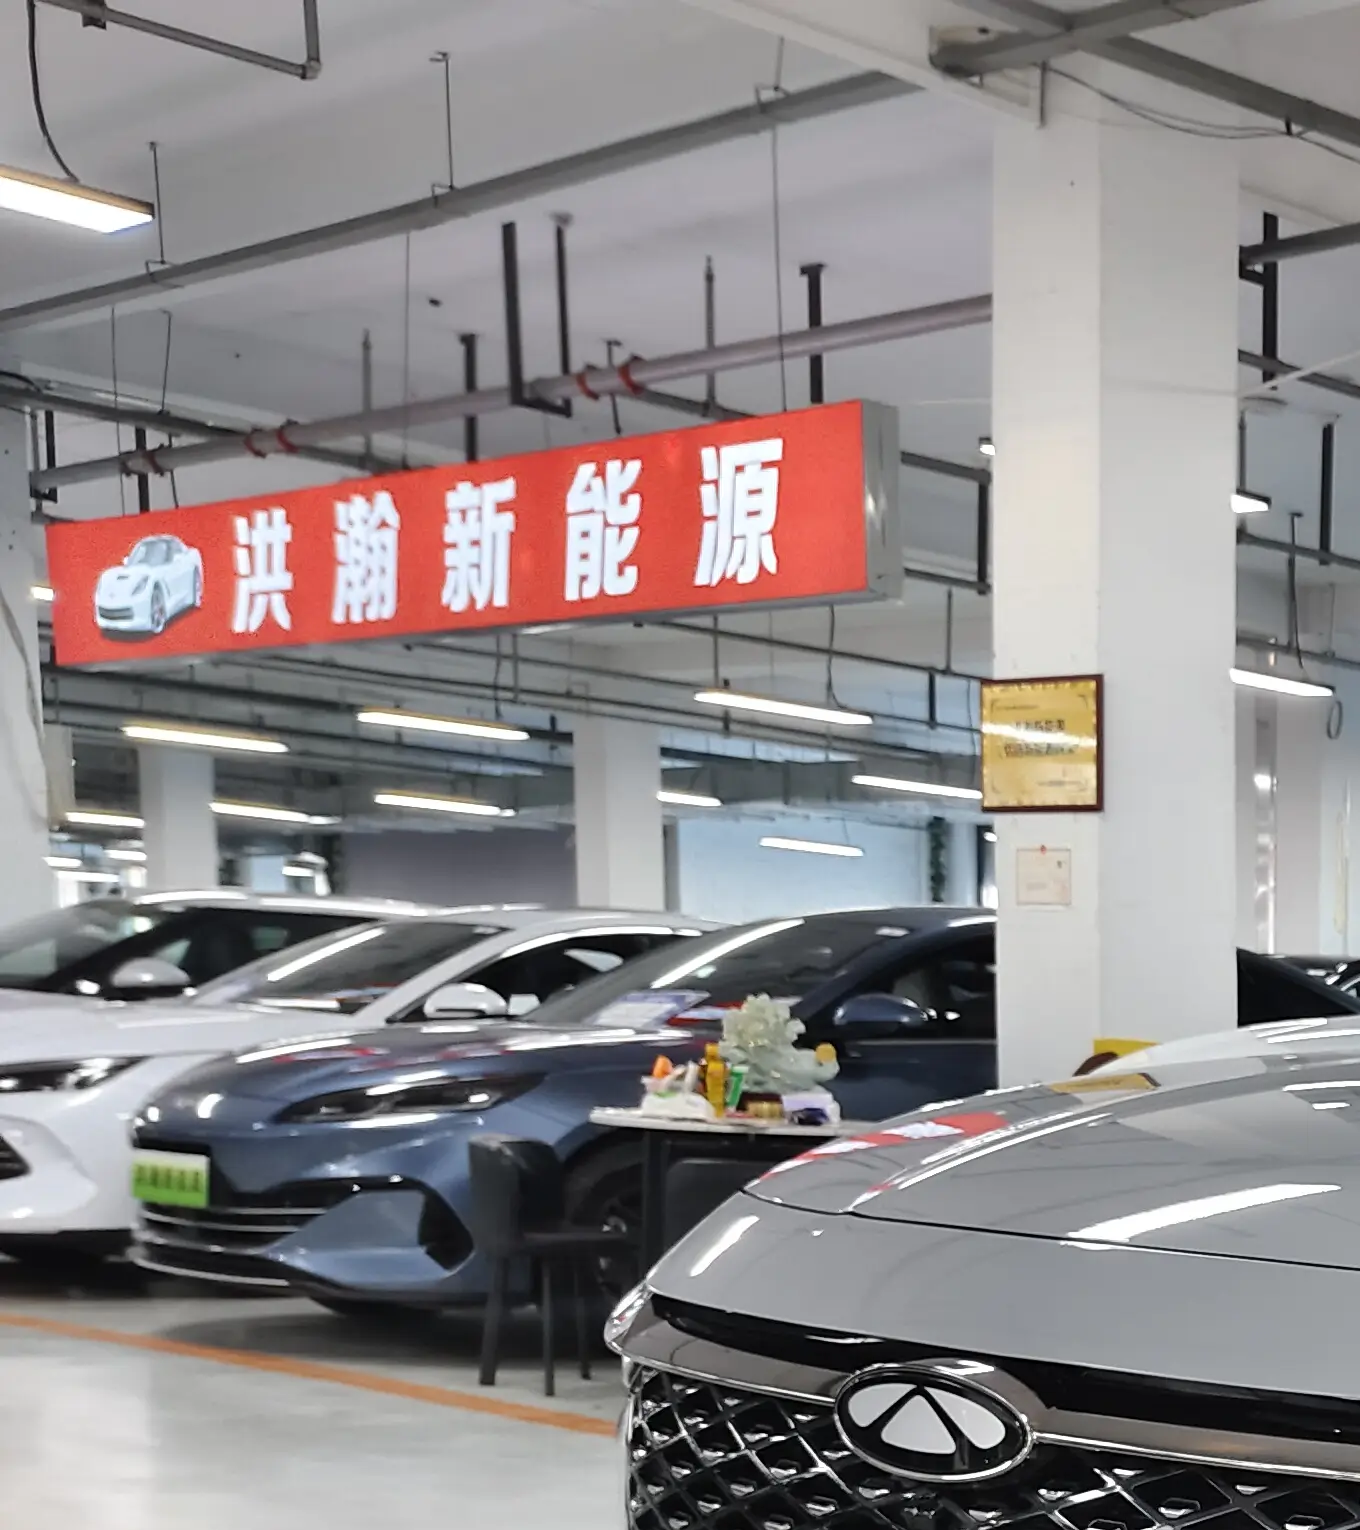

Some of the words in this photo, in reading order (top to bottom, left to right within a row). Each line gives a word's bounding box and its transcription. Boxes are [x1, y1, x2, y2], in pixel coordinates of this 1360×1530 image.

[231, 437, 784, 634] 洪瀚新能源
